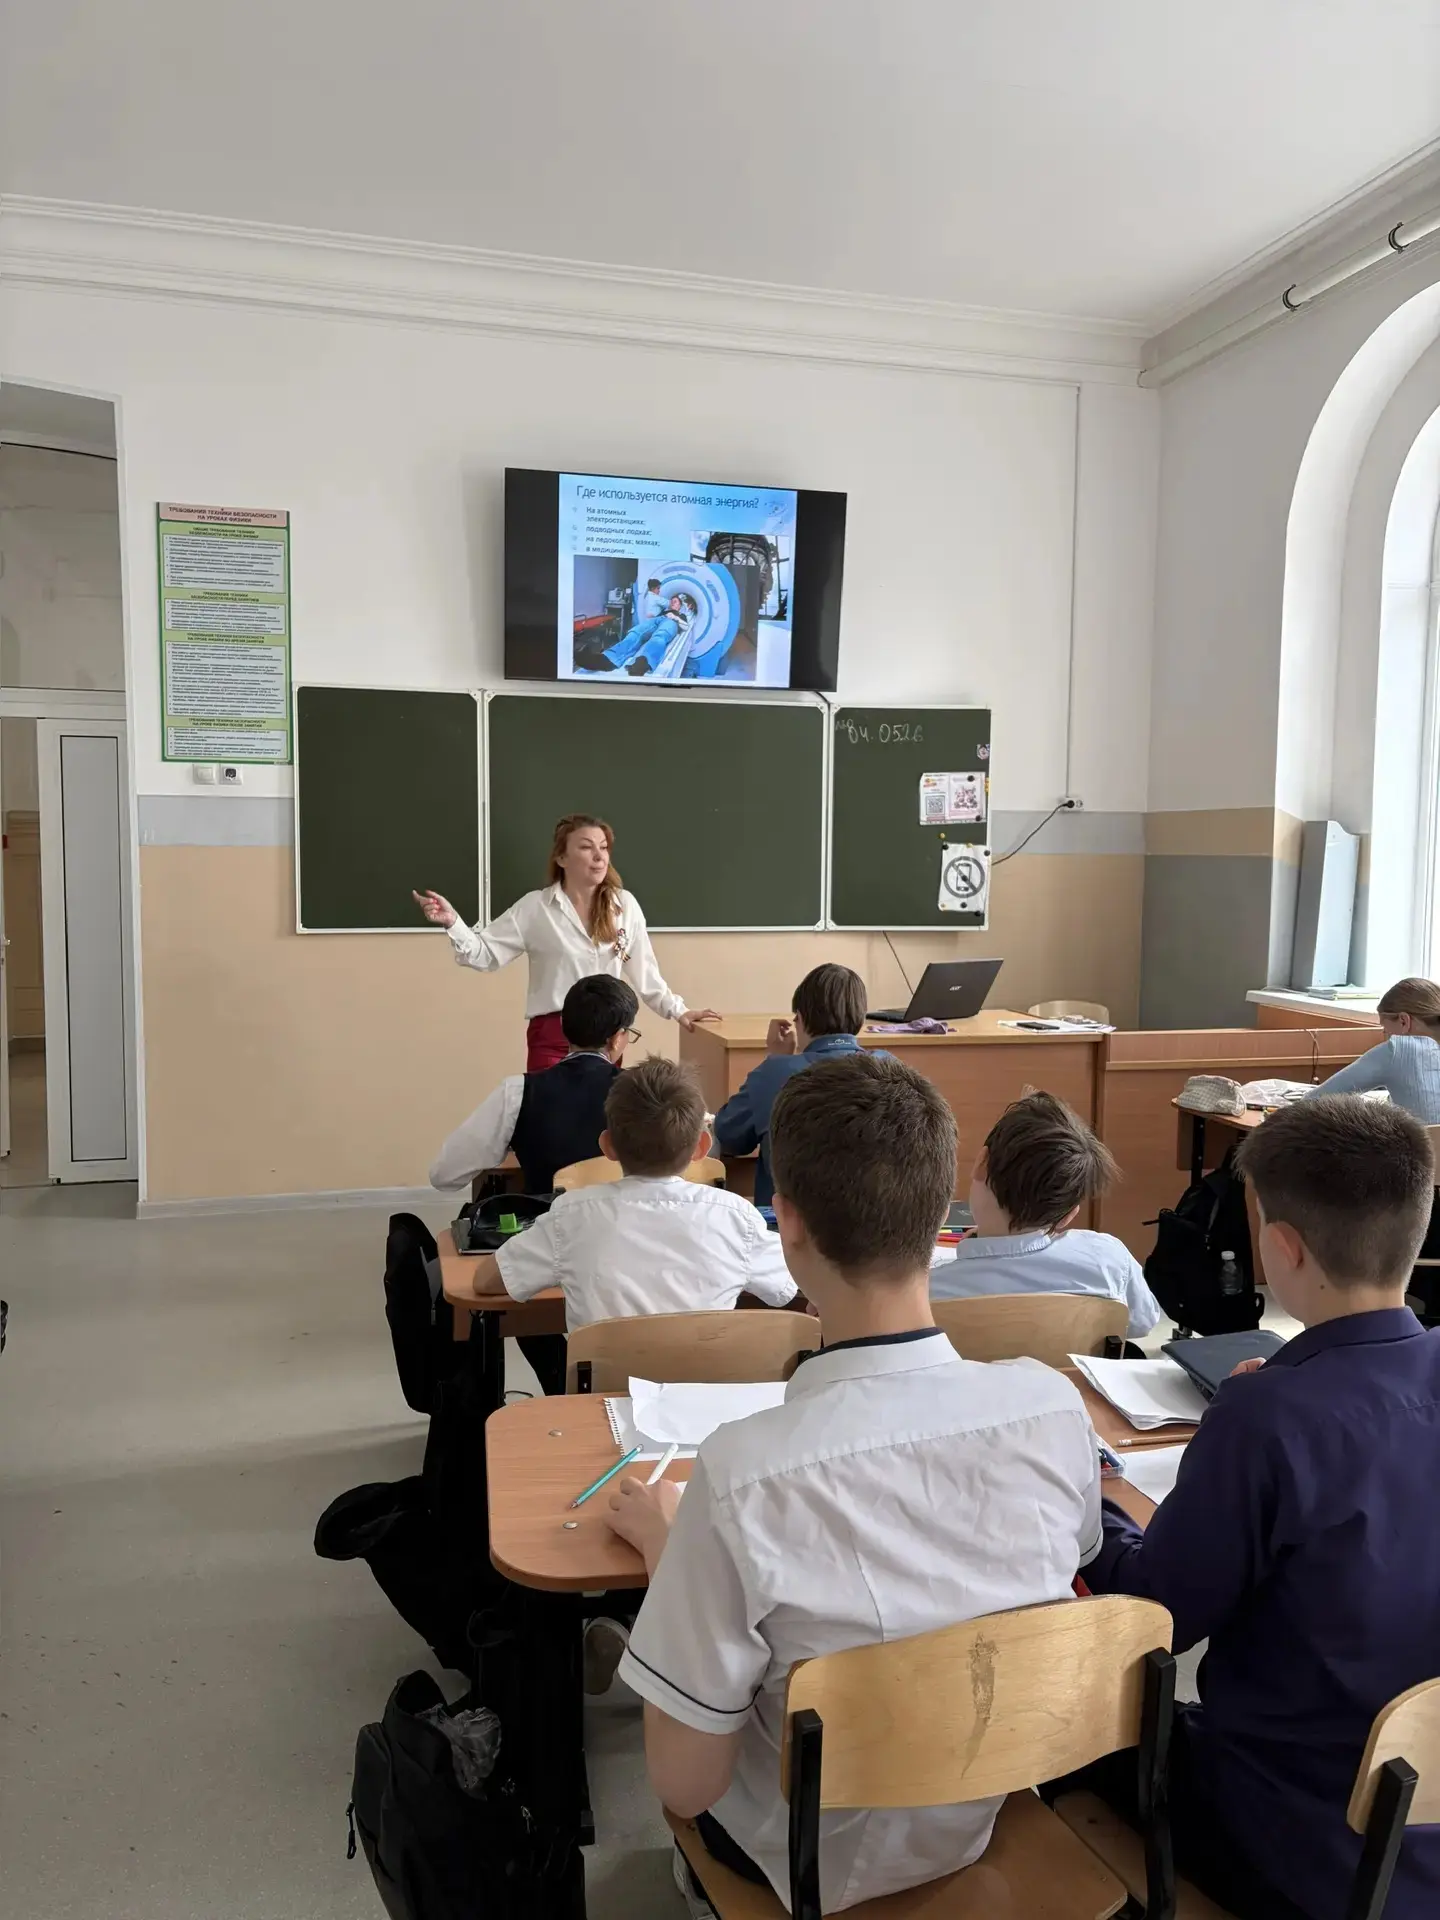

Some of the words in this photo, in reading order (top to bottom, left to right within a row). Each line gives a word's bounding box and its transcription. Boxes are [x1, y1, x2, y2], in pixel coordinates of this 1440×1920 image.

[576, 485, 596, 499] Где
[599, 489, 668, 503] используется
[670, 495, 712, 505] атомная
[715, 497, 759, 509] энергия?
[586, 506, 595, 514] На
[233, 511, 277, 519] БЕЗОПАСНОСТИ
[586, 526, 624, 534] подводных
[592, 547, 625, 555] медицине
